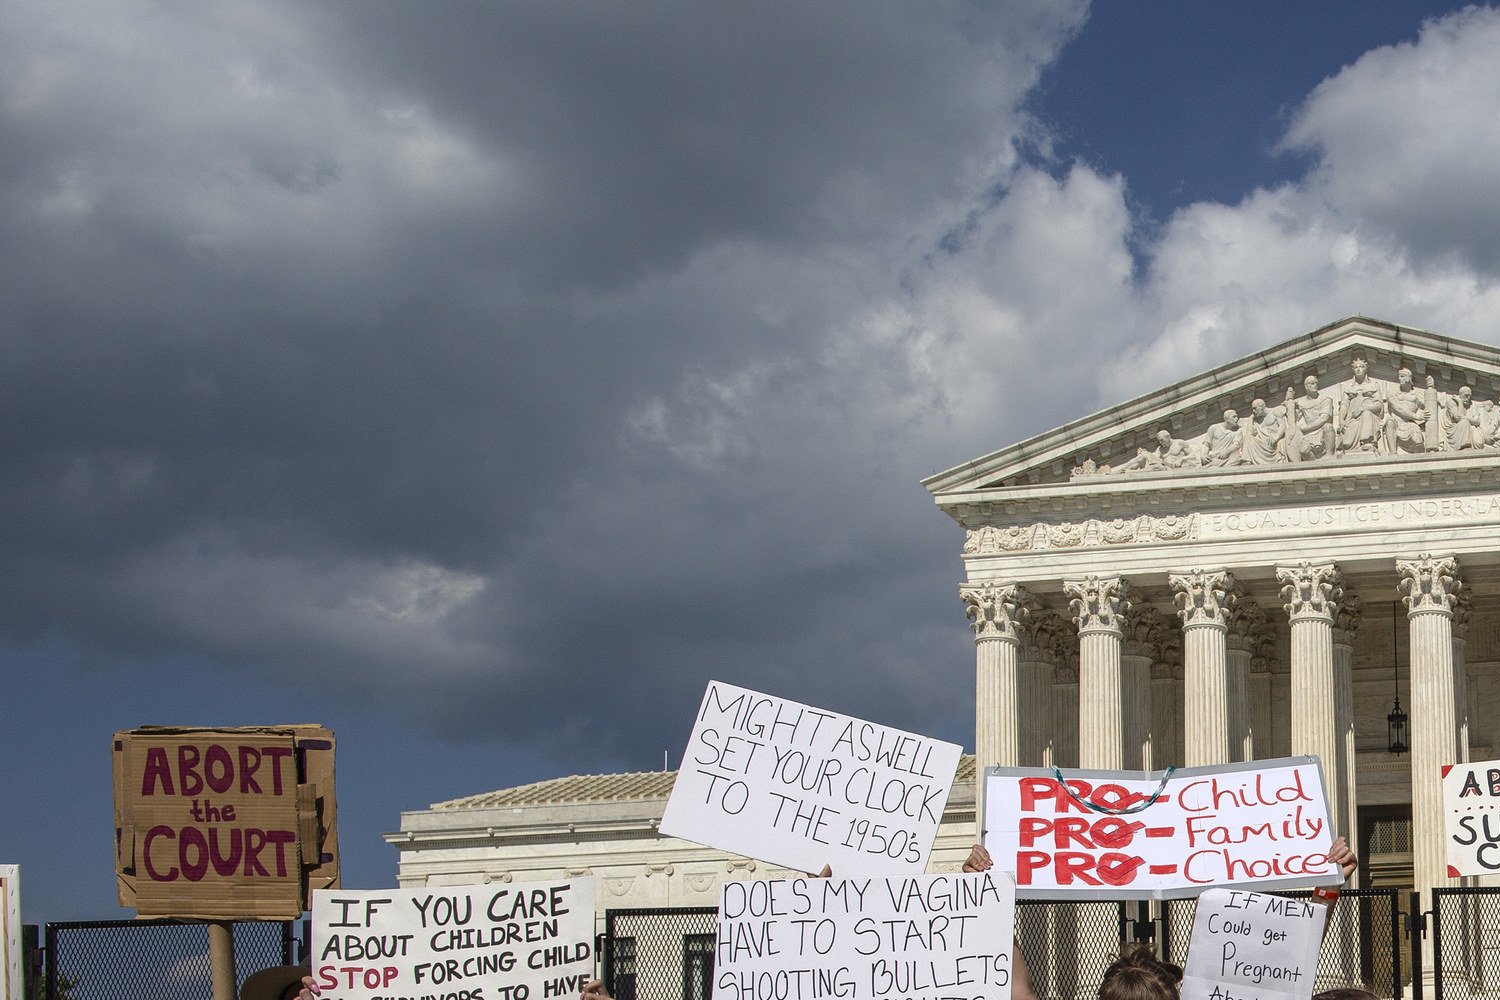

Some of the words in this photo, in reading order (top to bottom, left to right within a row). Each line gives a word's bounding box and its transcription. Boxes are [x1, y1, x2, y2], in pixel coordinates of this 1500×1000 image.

[1212, 510, 1288, 532] EQUAL
[1290, 504, 1380, 528] JUSTICE
[1391, 498, 1468, 521] UNDER
[700, 684, 837, 746] MIGHT
[141, 744, 293, 797] ABORT
[694, 728, 765, 774] SET
[771, 744, 844, 797] YOUR
[845, 767, 944, 825] CLOCK
[189, 799, 237, 823] the
[696, 769, 750, 815] TO
[770, 791, 842, 846] THE
[840, 817, 922, 864] 1950's
[143, 824, 296, 882] COURT
[329, 898, 393, 928] IF
[410, 894, 473, 927] YOU
[486, 885, 571, 923] CARE
[724, 878, 812, 920] DOES
[822, 878, 872, 914] MY
[885, 873, 1001, 914] VAGINA
[1223, 892, 1262, 909] IF
[1264, 898, 1316, 919] MEN
[321, 933, 415, 962] ABOUT
[430, 920, 559, 953] CHILDREN
[718, 920, 781, 967] HAVE
[790, 918, 837, 956] TO
[854, 915, 978, 957] START
[1208, 913, 1252, 937] Could
[1263, 929, 1288, 945] get
[318, 966, 399, 991] STOP
[414, 956, 521, 986] FORCING
[527, 942, 591, 971] CHILD
[871, 953, 1010, 996] BULLETS
[1220, 941, 1303, 984] Pregnant
[543, 972, 592, 999] HAVE
